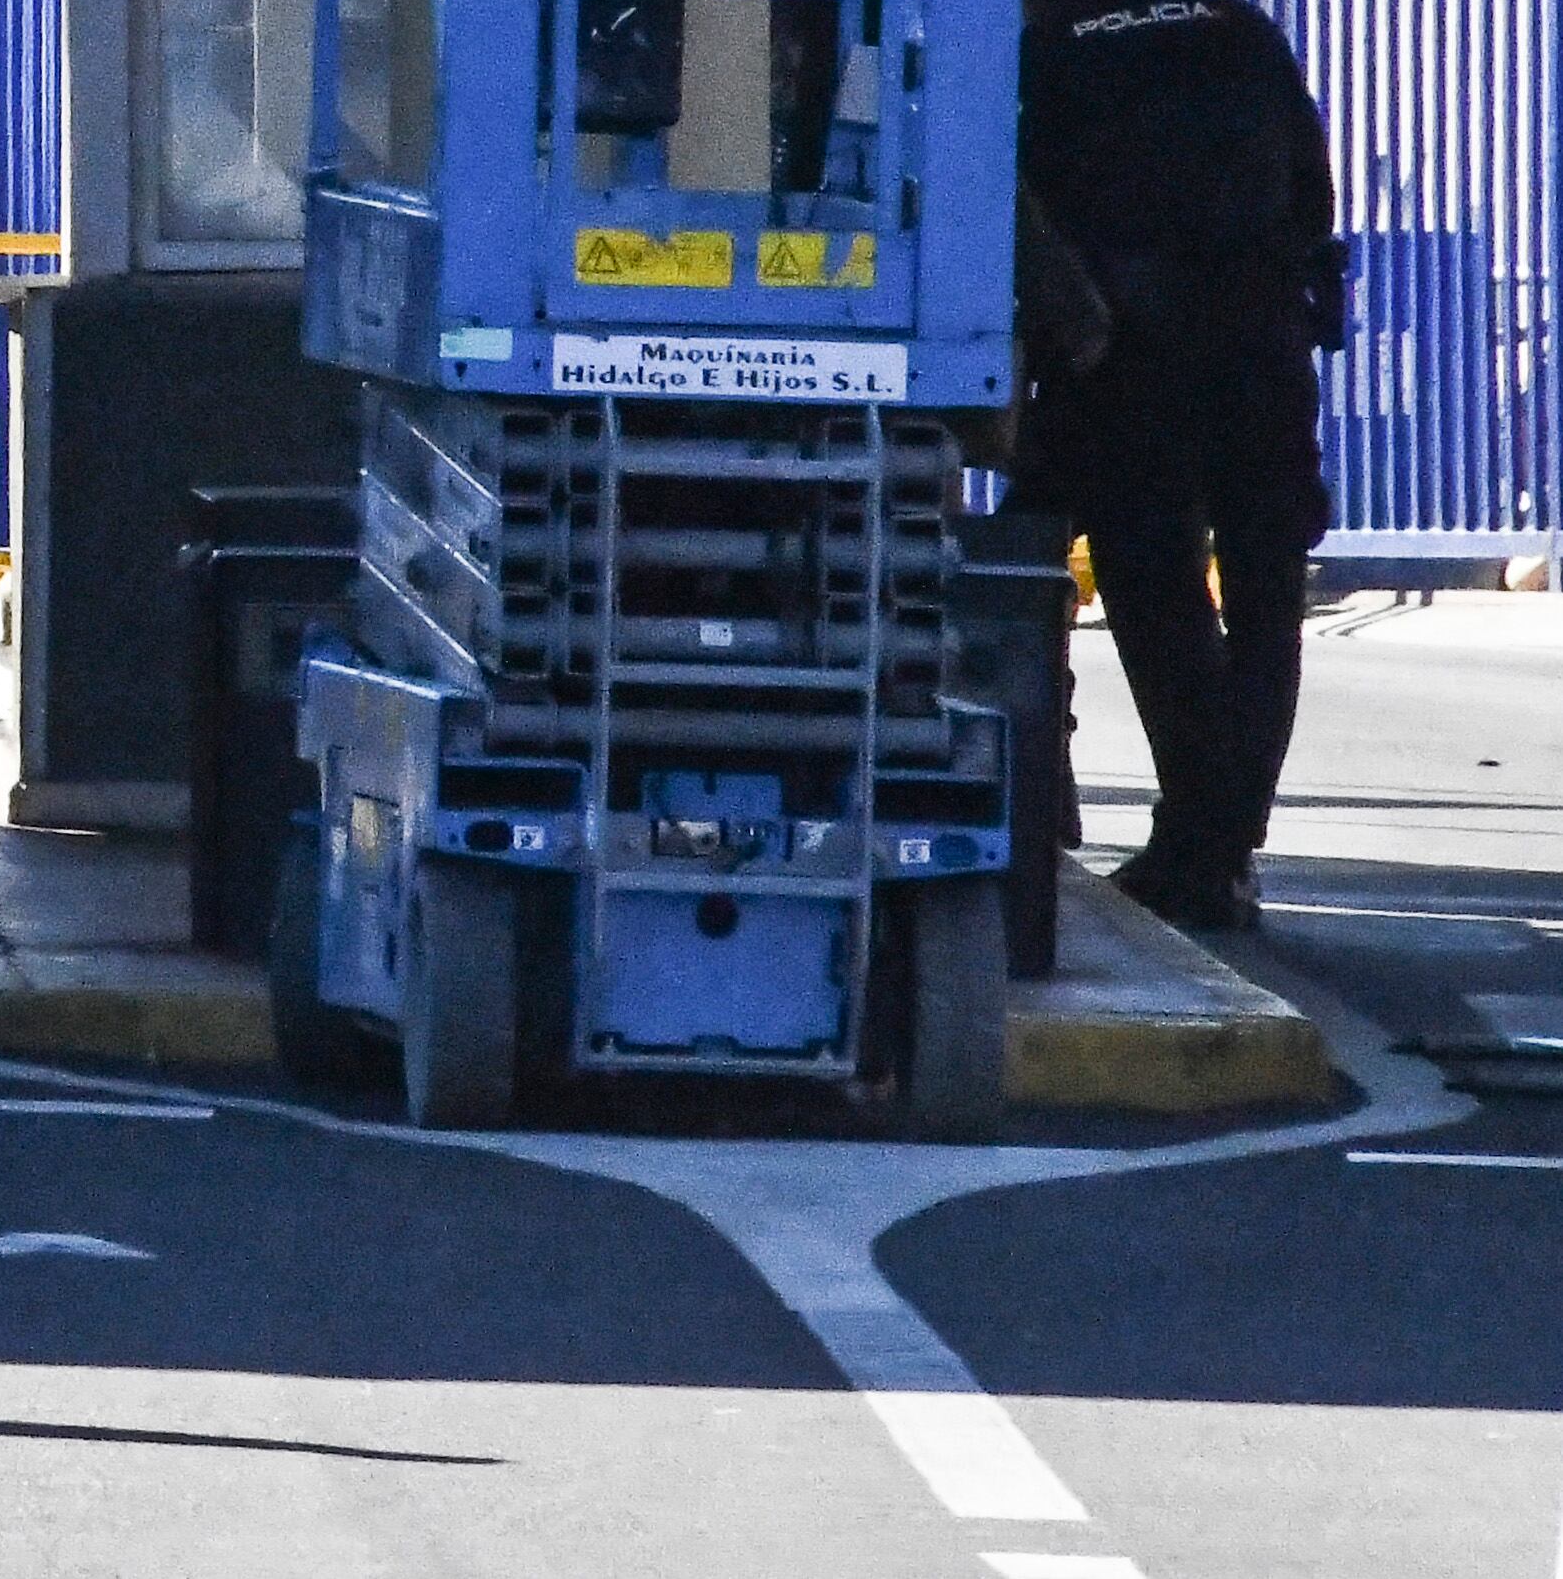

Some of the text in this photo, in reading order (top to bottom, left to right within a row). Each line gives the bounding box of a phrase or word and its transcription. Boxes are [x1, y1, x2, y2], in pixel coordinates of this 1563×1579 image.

[1072, 1, 1213, 37] POLICIA
[702, 368, 721, 388] E
[736, 370, 818, 394] Hijos
[832, 373, 893, 394] S.L.
